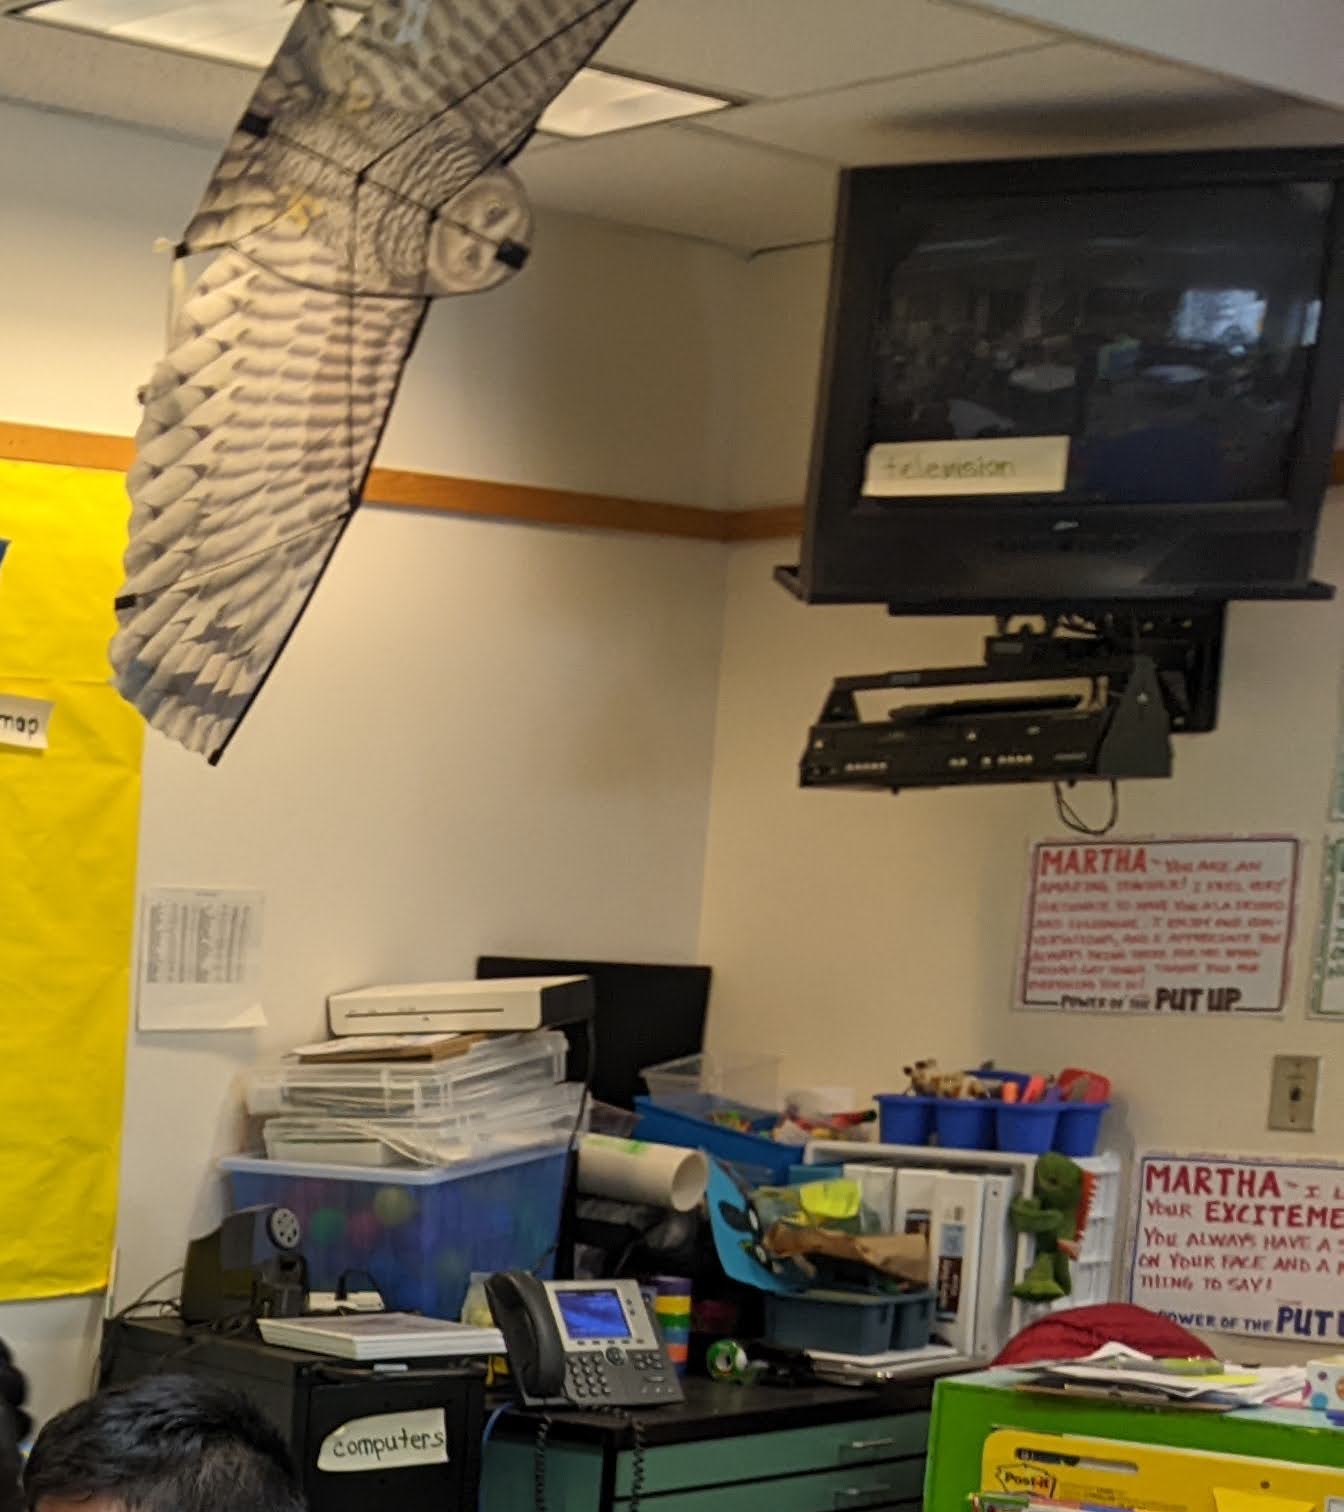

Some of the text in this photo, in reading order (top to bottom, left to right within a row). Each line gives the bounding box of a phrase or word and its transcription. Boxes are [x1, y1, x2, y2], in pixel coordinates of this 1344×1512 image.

[1041, 847, 1147, 877] MARTHA
[1155, 987, 1204, 1012] PUT
[1208, 988, 1243, 1012] UP
[1145, 1164, 1281, 1199] MARTHA
[1186, 1232, 1256, 1249] ALWAYS
[1264, 1235, 1310, 1251] HAVE
[1316, 1238, 1332, 1252] A
[1138, 1253, 1160, 1268] ON
[1222, 1254, 1265, 1271] FACE
[1273, 1257, 1310, 1273] AND
[1315, 1260, 1330, 1273] A
[1140, 1274, 1273, 1293] THING TO SAY!
[1220, 1316, 1239, 1329] OF
[1245, 1318, 1272, 1332] THE
[1276, 1306, 1334, 1338] PUT
[333, 1427, 444, 1461] computers
